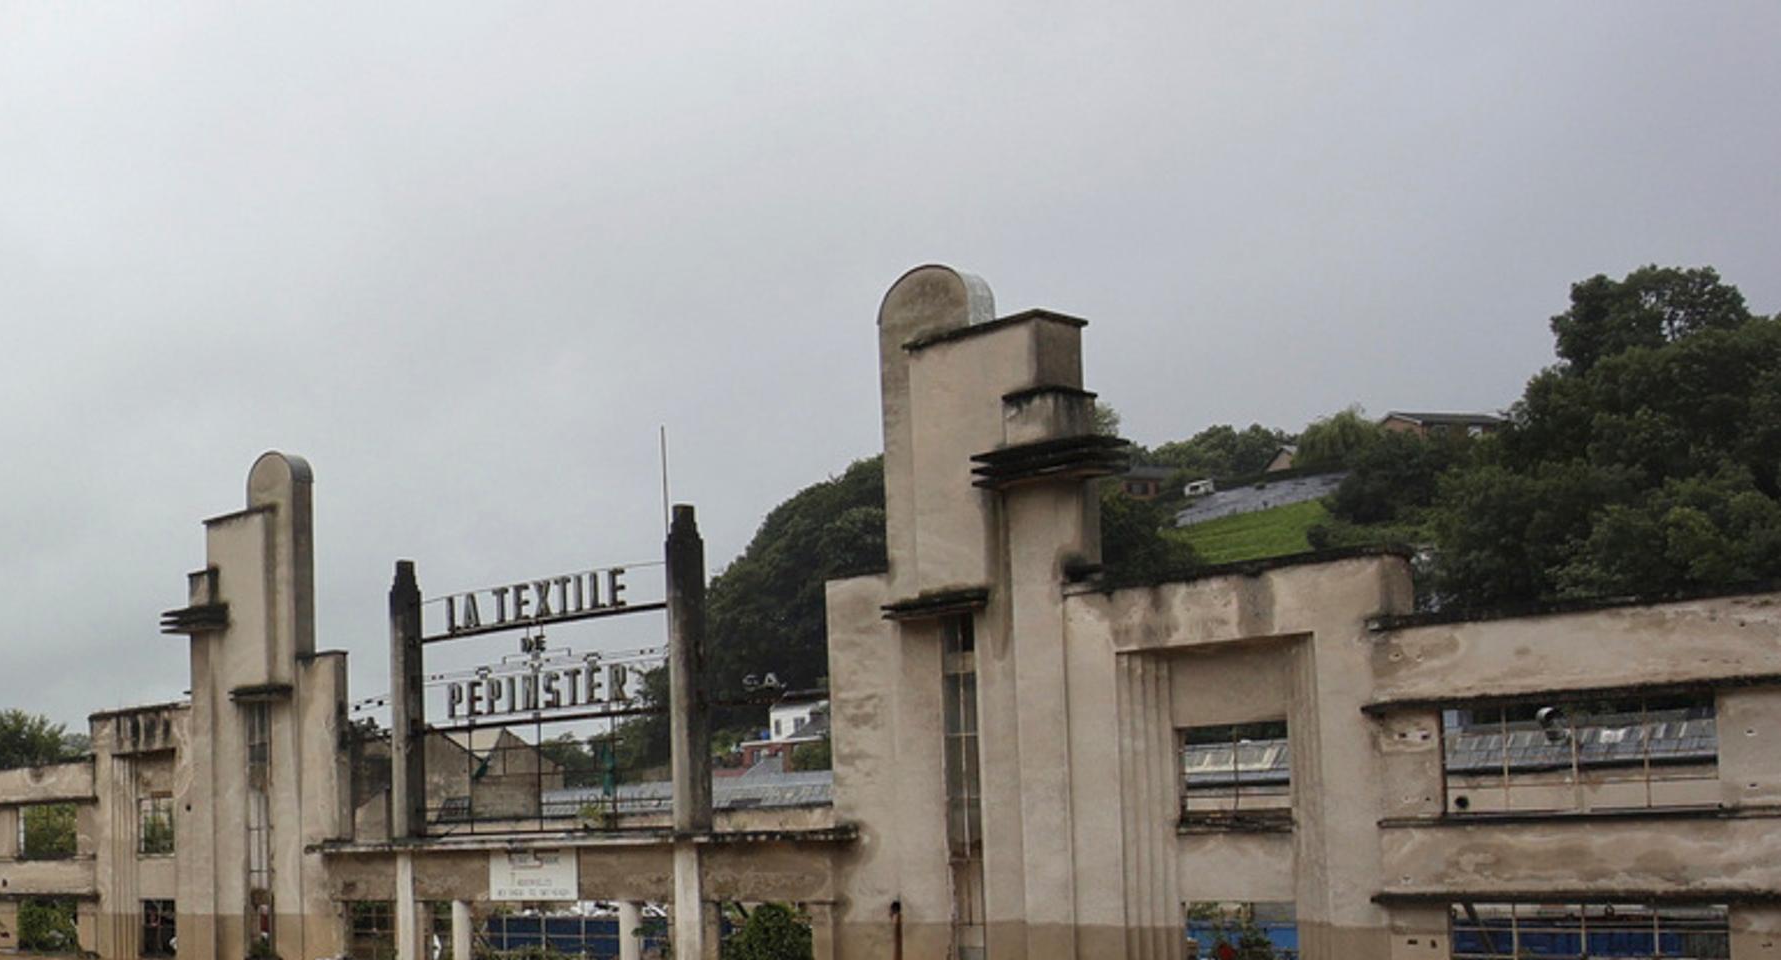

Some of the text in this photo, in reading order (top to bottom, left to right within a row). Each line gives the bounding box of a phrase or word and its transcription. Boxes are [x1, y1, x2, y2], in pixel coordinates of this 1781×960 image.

[447, 568, 626, 633] LA TEXTILE
[521, 634, 546, 654] DE
